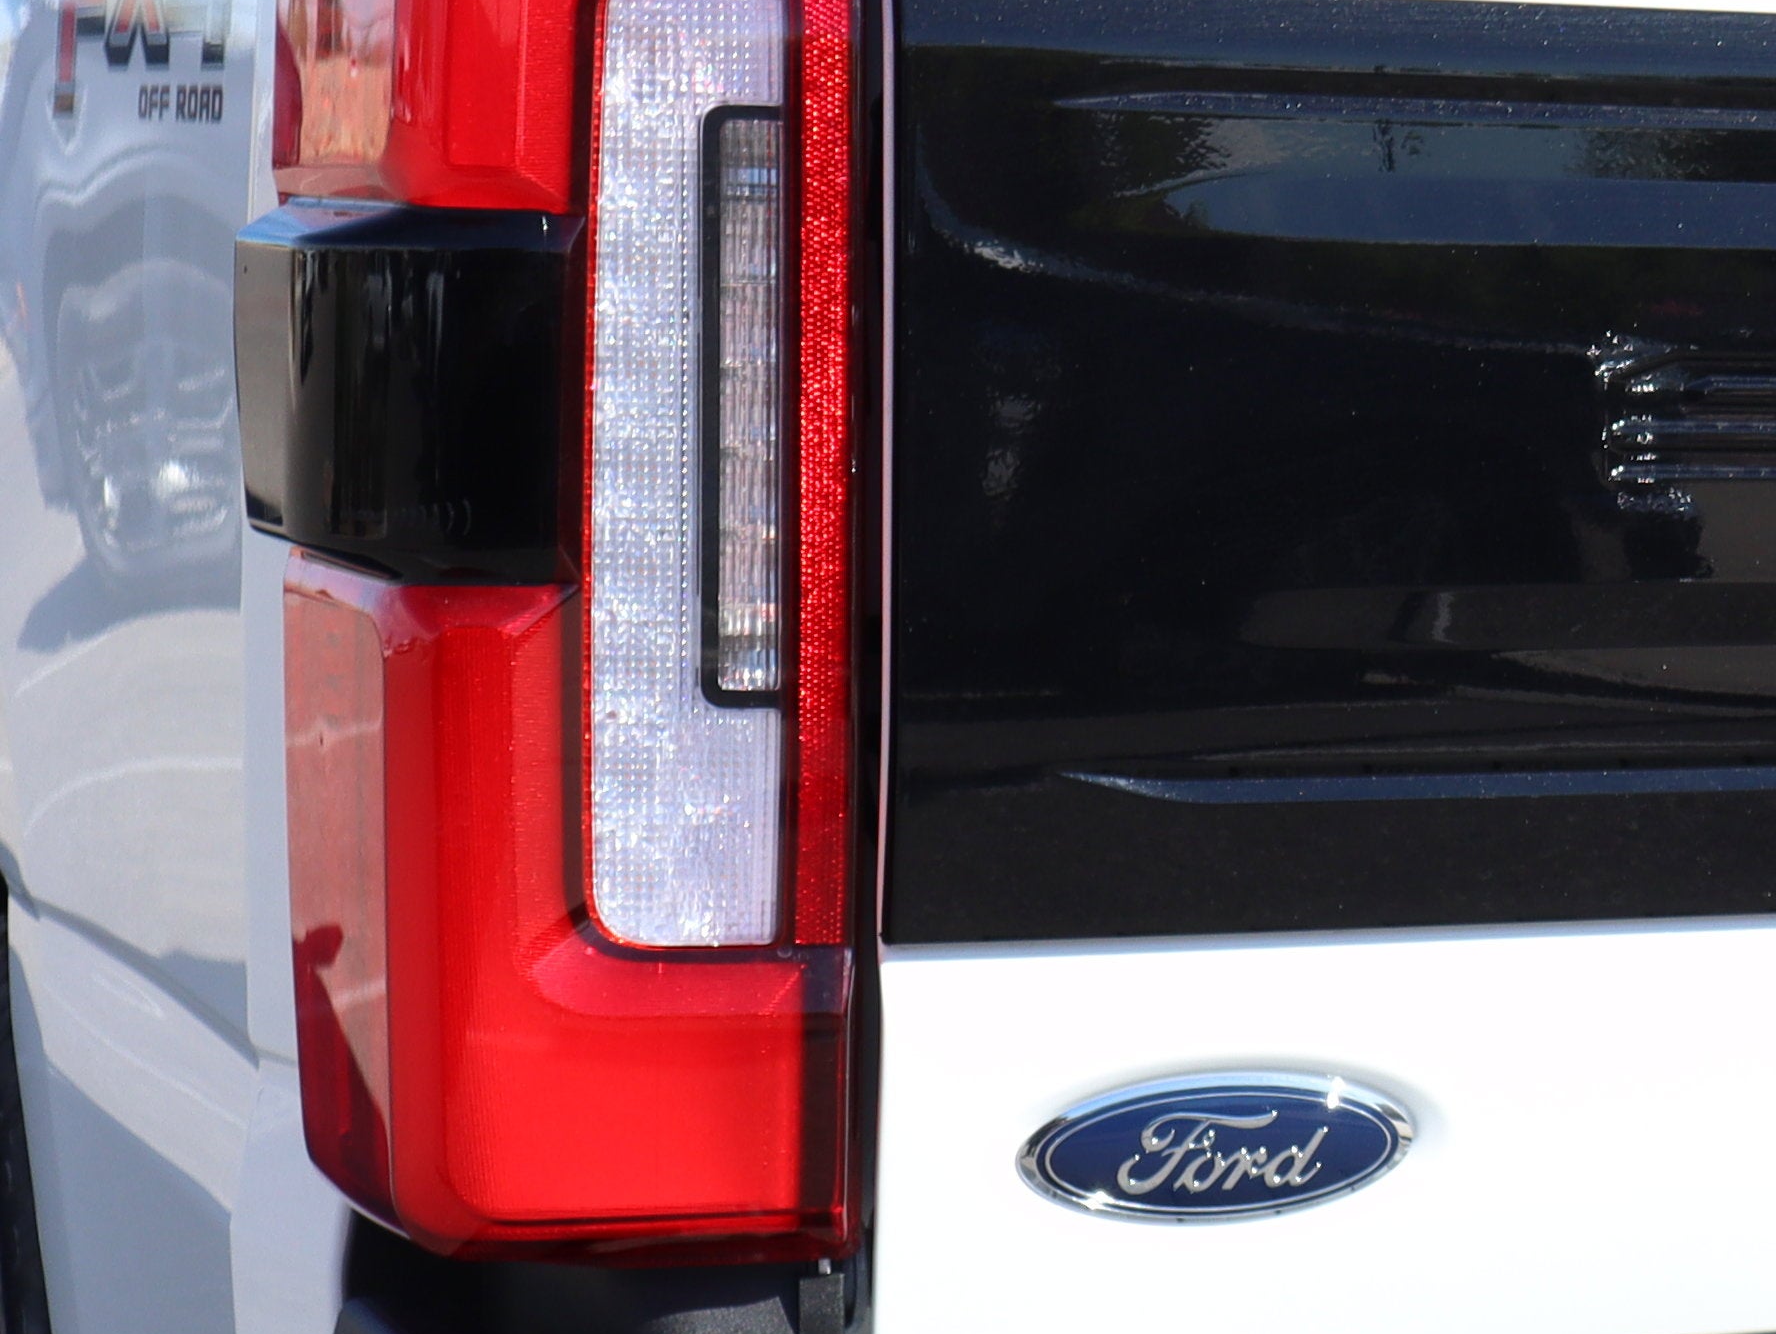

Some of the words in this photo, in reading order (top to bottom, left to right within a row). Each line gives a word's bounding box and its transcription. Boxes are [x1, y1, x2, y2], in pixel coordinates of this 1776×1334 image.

[138, 83, 170, 121] OFF
[175, 83, 224, 124] ROAD
[1116, 1111, 1330, 1196] Ford
